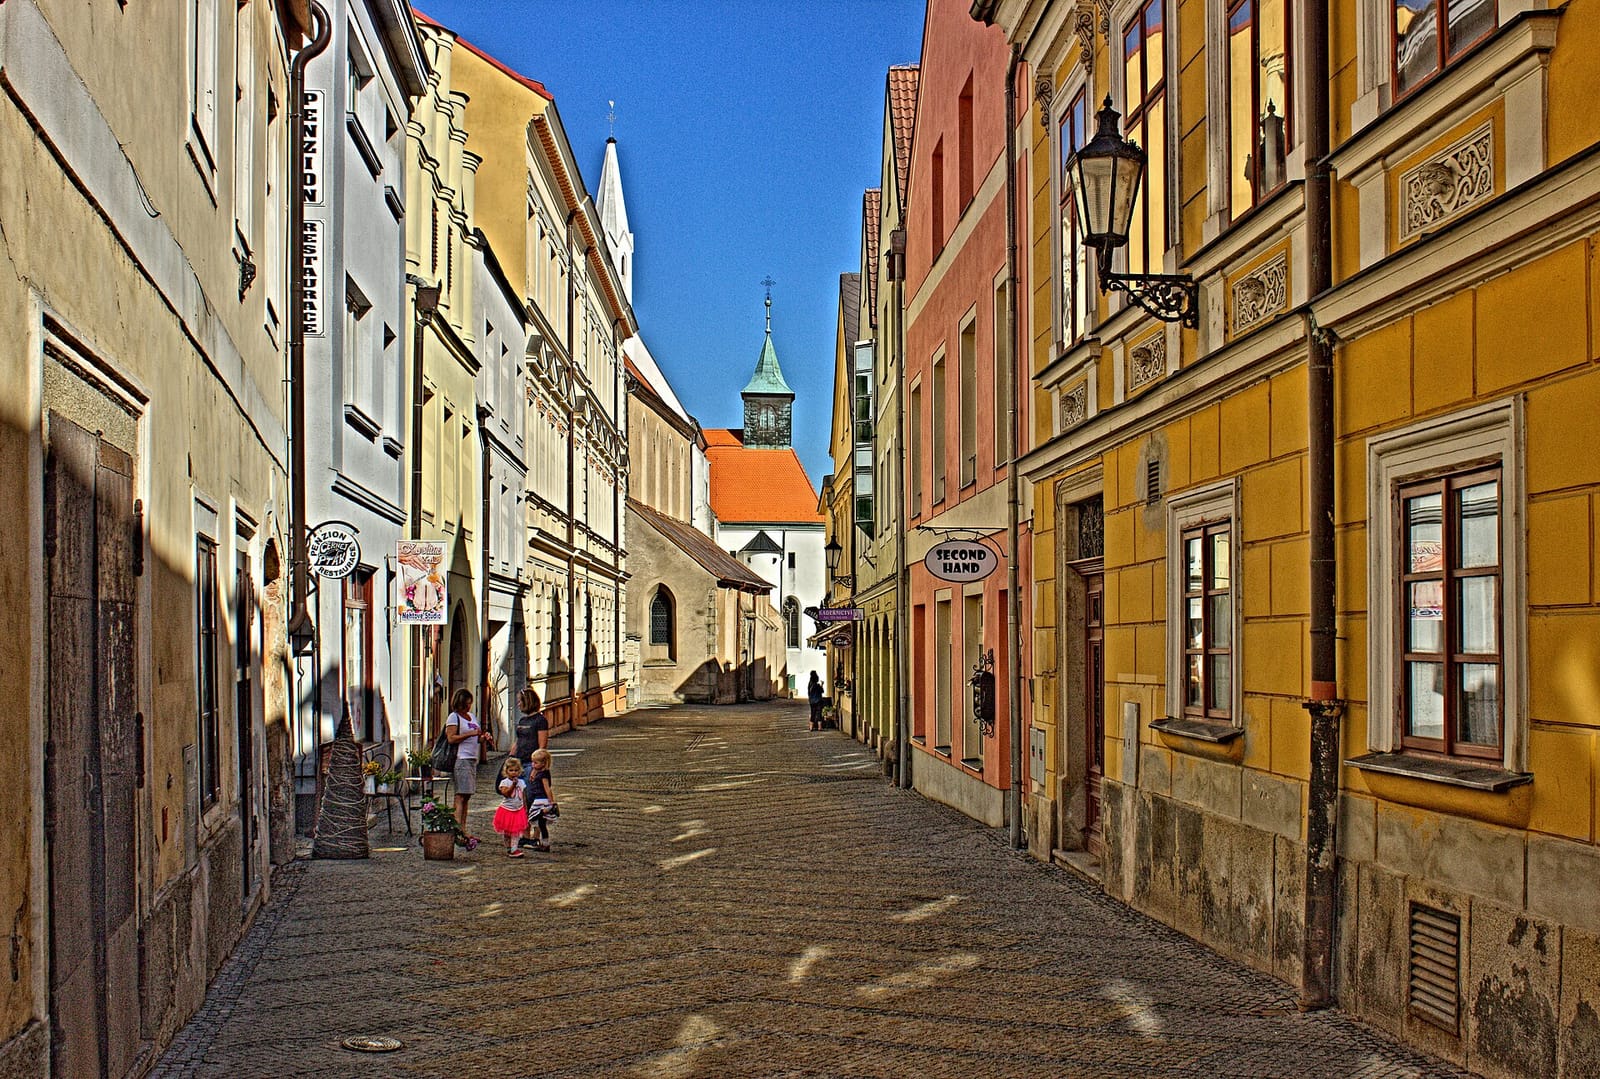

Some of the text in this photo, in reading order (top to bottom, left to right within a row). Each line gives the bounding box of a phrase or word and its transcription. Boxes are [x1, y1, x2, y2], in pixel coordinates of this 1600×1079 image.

[304, 93, 318, 202] PENZION
[304, 223, 318, 333] RESTAURACE
[311, 531, 347, 556] PENZION
[936, 549, 986, 560] SECOND
[319, 545, 356, 576] RESTAURACE
[943, 563, 980, 573] HAND
[425, 611, 441, 620] Studio
